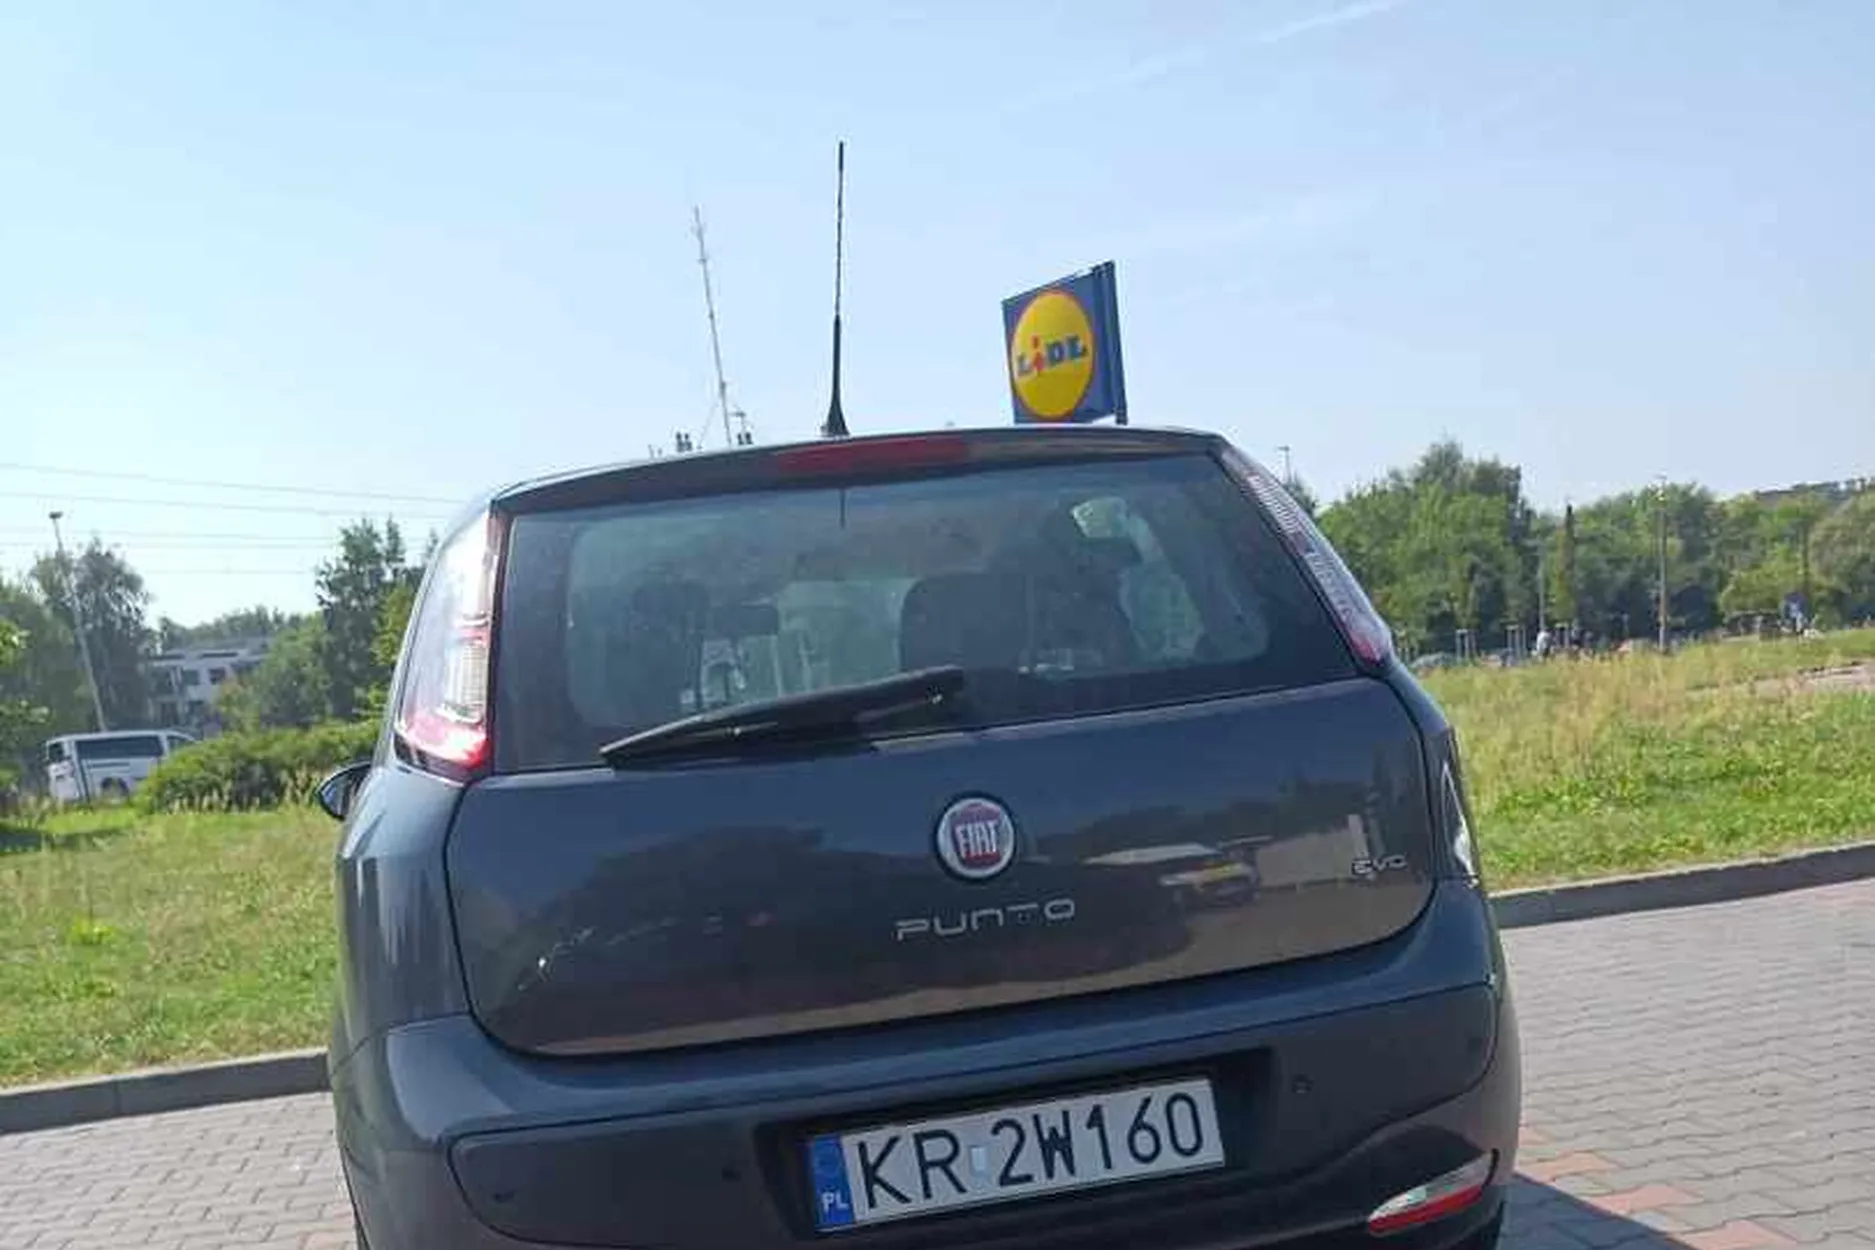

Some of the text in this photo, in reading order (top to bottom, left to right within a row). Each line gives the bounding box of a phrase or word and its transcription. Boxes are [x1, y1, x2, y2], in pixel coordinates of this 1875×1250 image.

[954, 819, 999, 859] FIAT
[857, 1092, 1203, 1209] KR 2W160
[821, 1189, 850, 1213] PL
